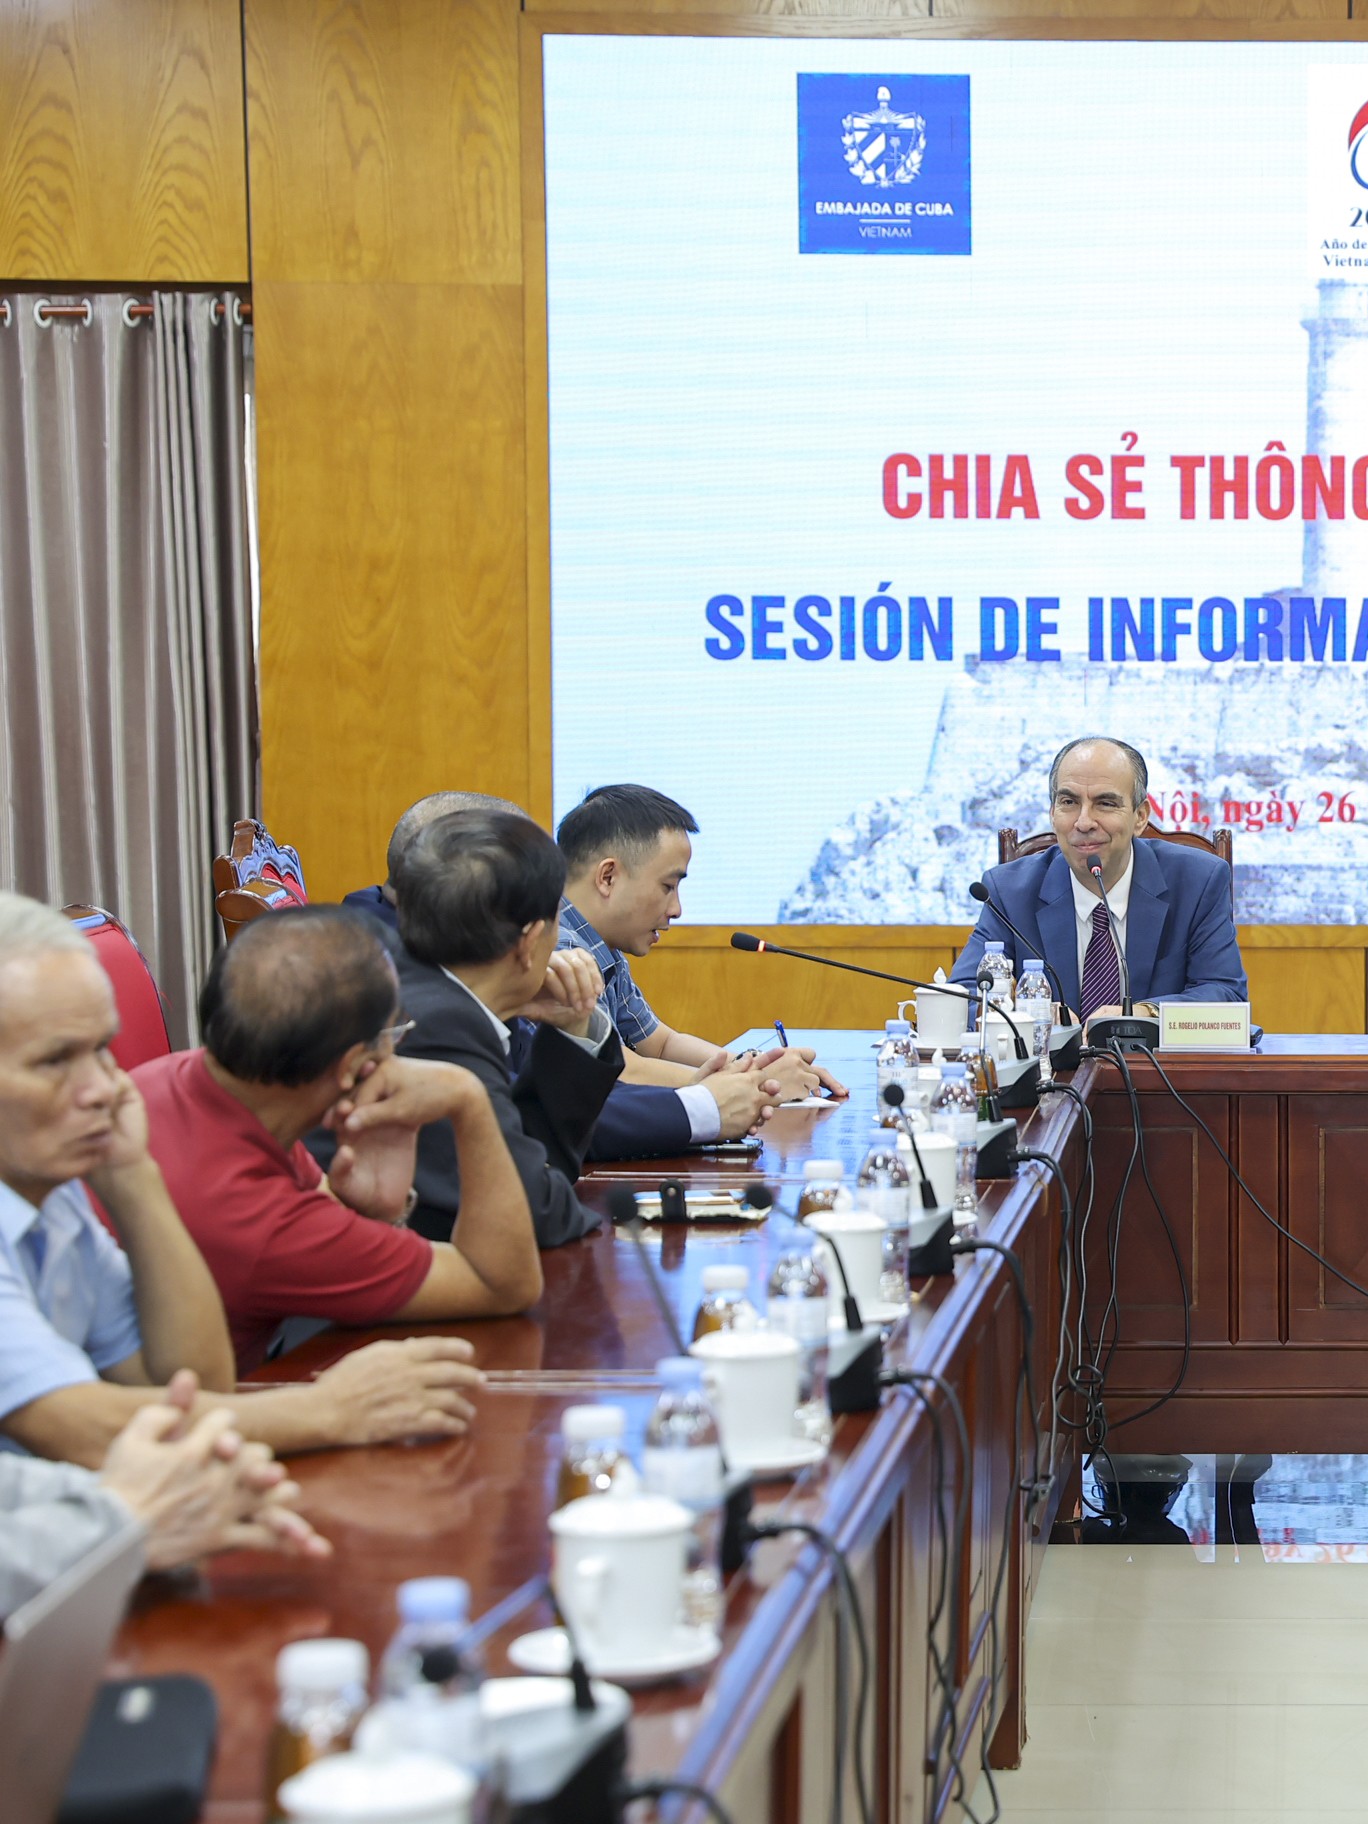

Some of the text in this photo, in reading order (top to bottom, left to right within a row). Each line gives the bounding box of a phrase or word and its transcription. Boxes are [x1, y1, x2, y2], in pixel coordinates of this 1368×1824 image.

[815, 201, 954, 216] EMBAJADA DE CUBA
[859, 226, 912, 237] VIETNAM
[1321, 239, 1348, 250] Año
[1352, 239, 1368, 250] de
[882, 453, 1041, 520] CHIA
[1064, 431, 1147, 520] SẺ
[704, 581, 954, 661] SESIÓN
[980, 597, 1061, 662] DE
[1223, 791, 1305, 832] ngày
[1317, 791, 1357, 823] 26
[1179, 1021, 1198, 1030] ROGELIO
[1199, 1021, 1220, 1030] POLANCO
[1221, 1021, 1241, 1030] FUENTES
